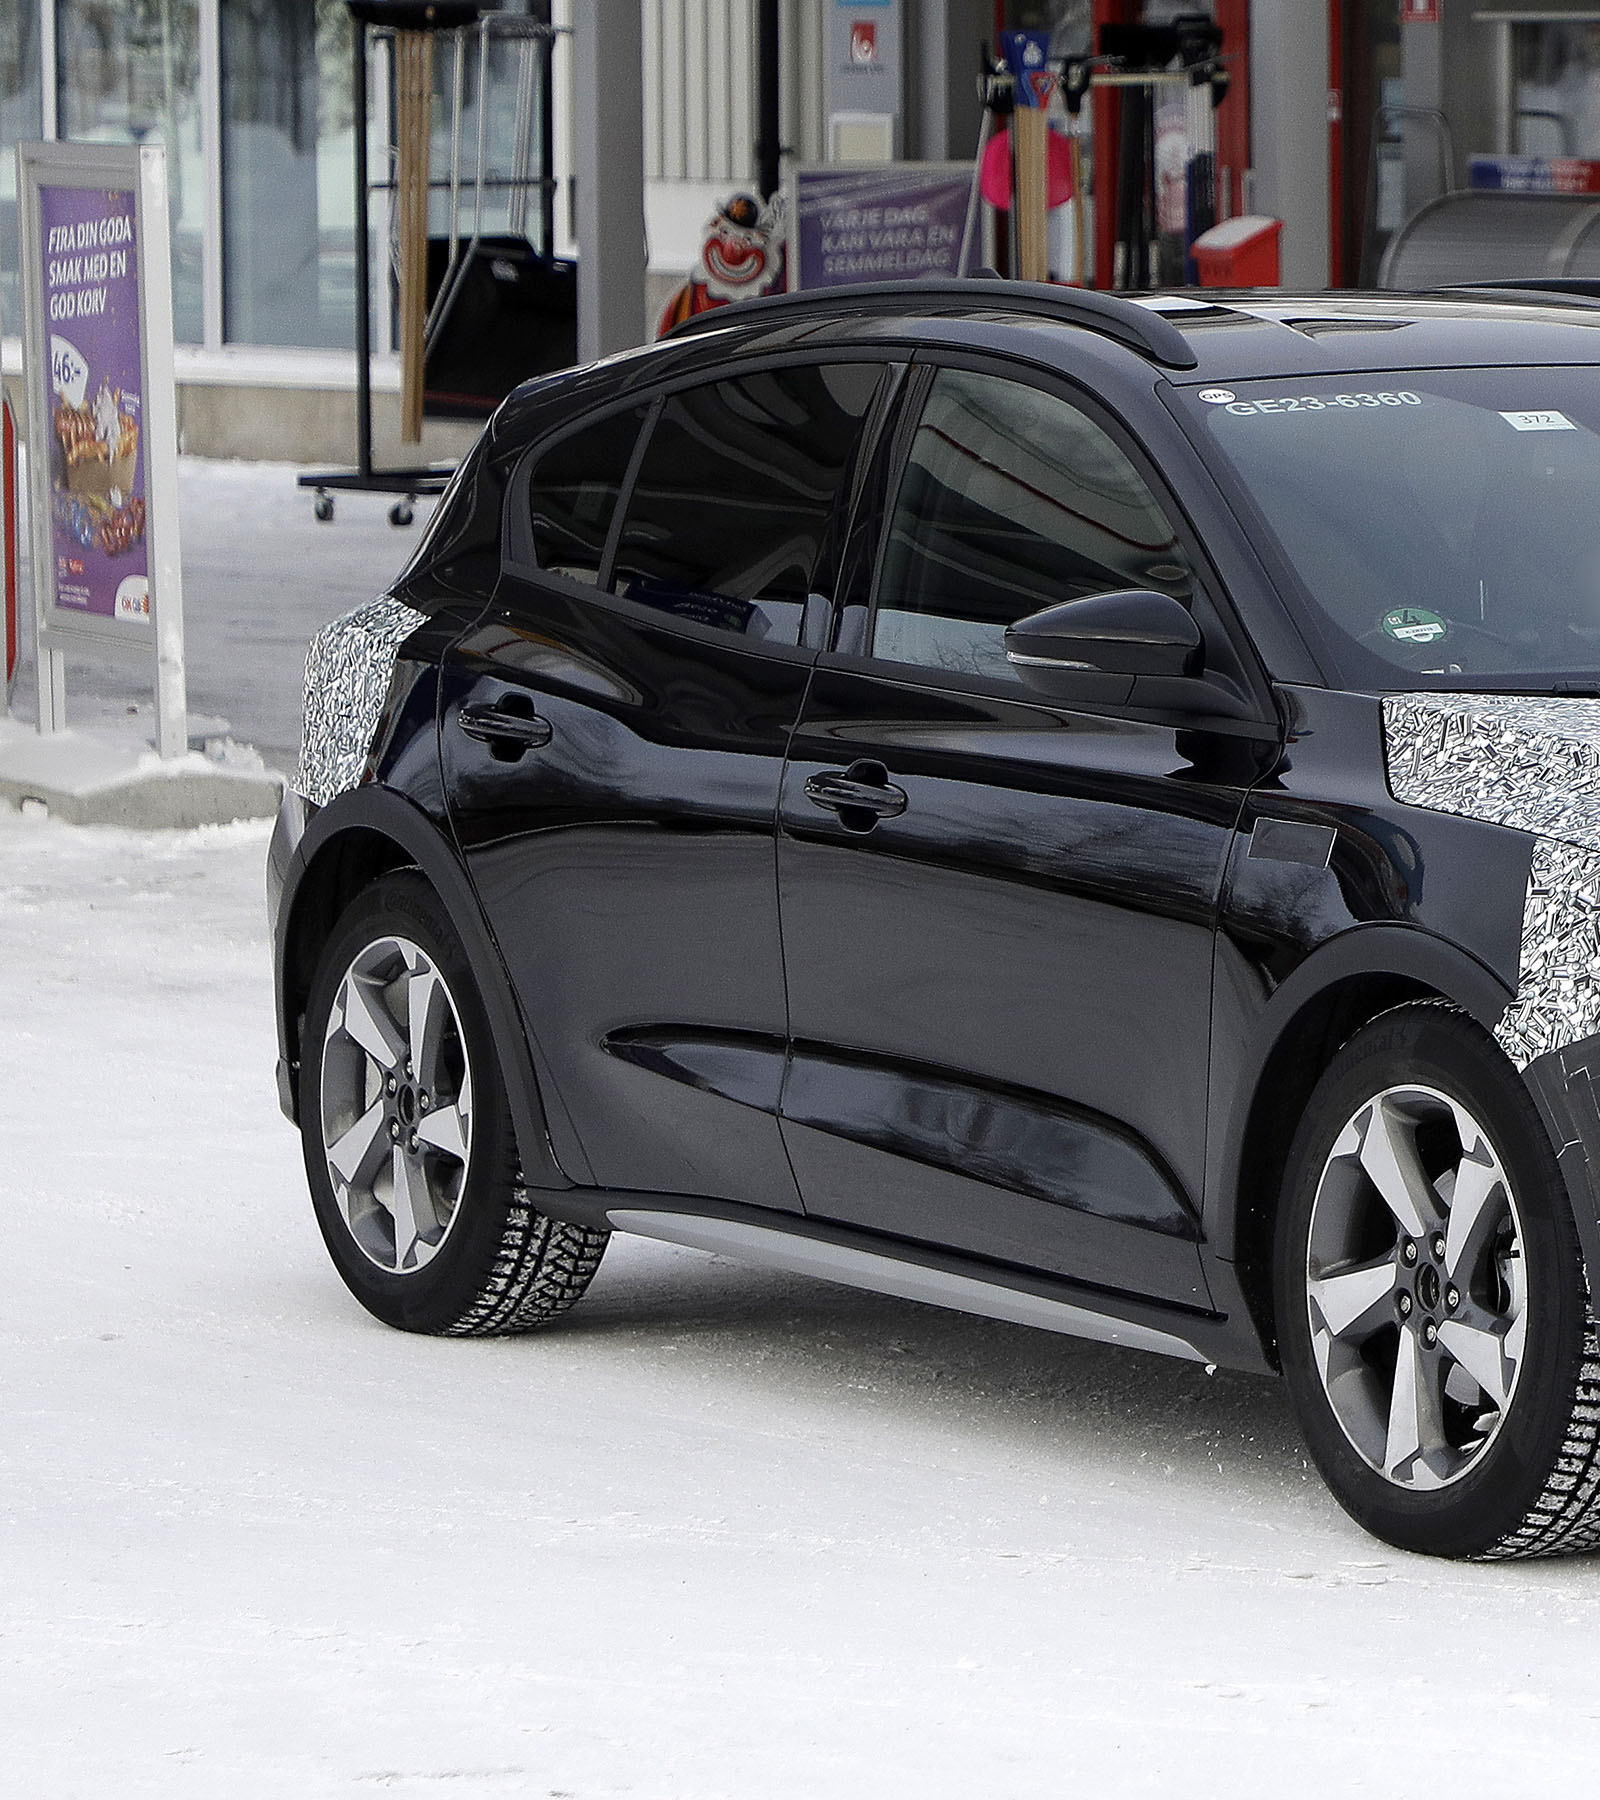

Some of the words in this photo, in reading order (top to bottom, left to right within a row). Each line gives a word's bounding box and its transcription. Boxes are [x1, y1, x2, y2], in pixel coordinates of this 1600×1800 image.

[884, 204, 929, 225] DAG
[49, 223, 76, 254] FIRA
[77, 220, 98, 249] DIN
[99, 215, 132, 247] GODA
[821, 230, 868, 252] KAN
[869, 227, 926, 249] VARA
[927, 224, 957, 247] EN
[49, 255, 82, 288] SMAK
[83, 253, 108, 281] MED
[110, 249, 126, 278] EN
[50, 291, 76, 321] GOD
[77, 286, 107, 317] KORV
[1202, 392, 1234, 401] GPS
[1225, 391, 1423, 416] GE23-6360
[1517, 414, 1555, 424] 372
